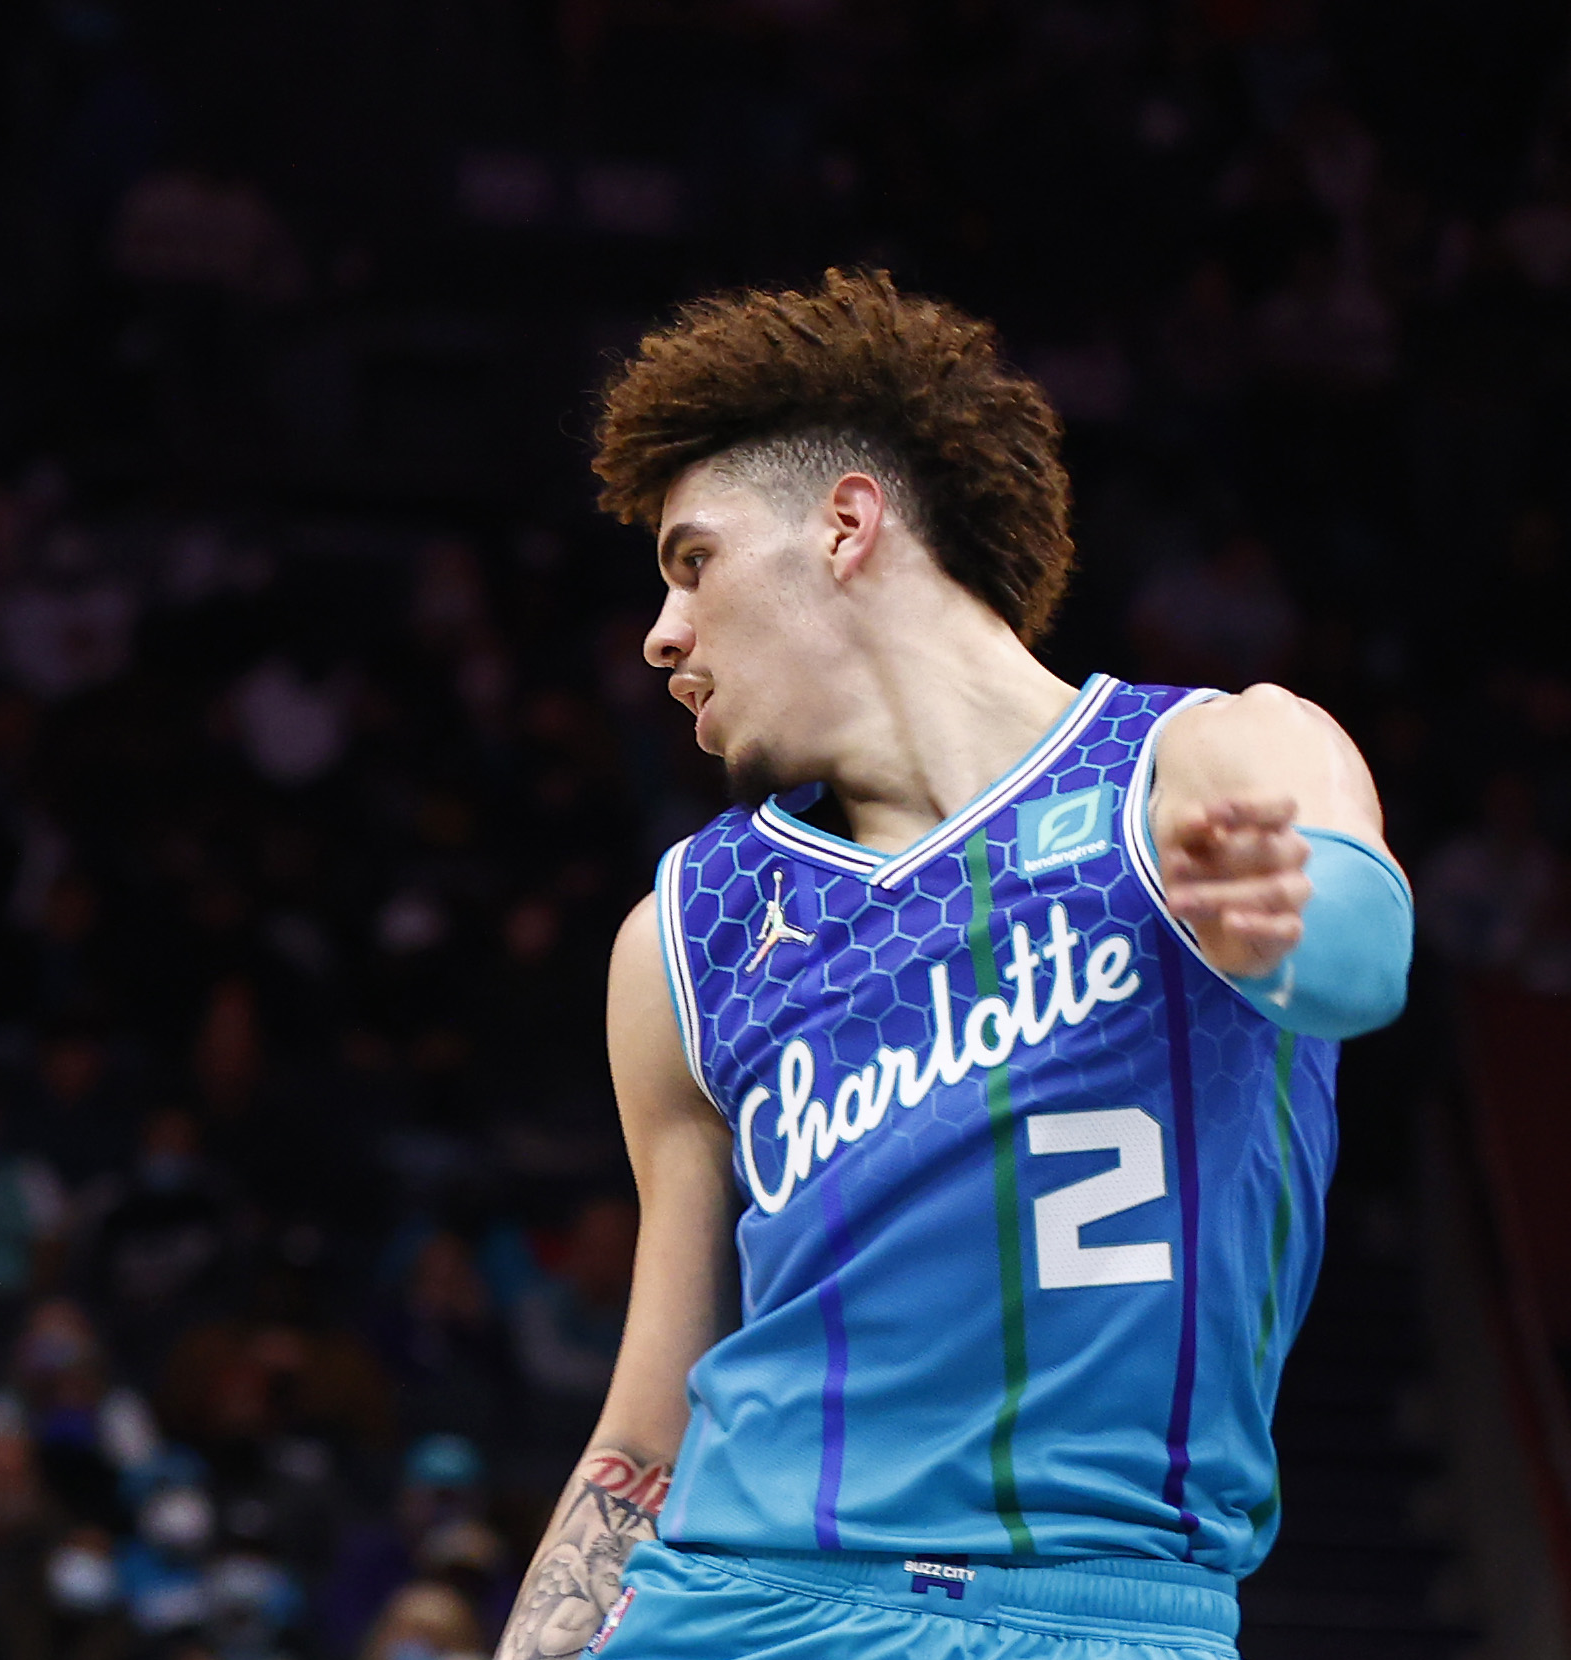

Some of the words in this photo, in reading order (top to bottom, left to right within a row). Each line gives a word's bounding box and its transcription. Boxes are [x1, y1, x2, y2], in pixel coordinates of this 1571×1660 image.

[1024, 839, 1107, 872] lendingtree
[737, 902, 1142, 1213] Charlotte
[1026, 1106, 1173, 1290] 2
[903, 1560, 942, 1577] BUZZ
[943, 1566, 977, 1582] CITY
